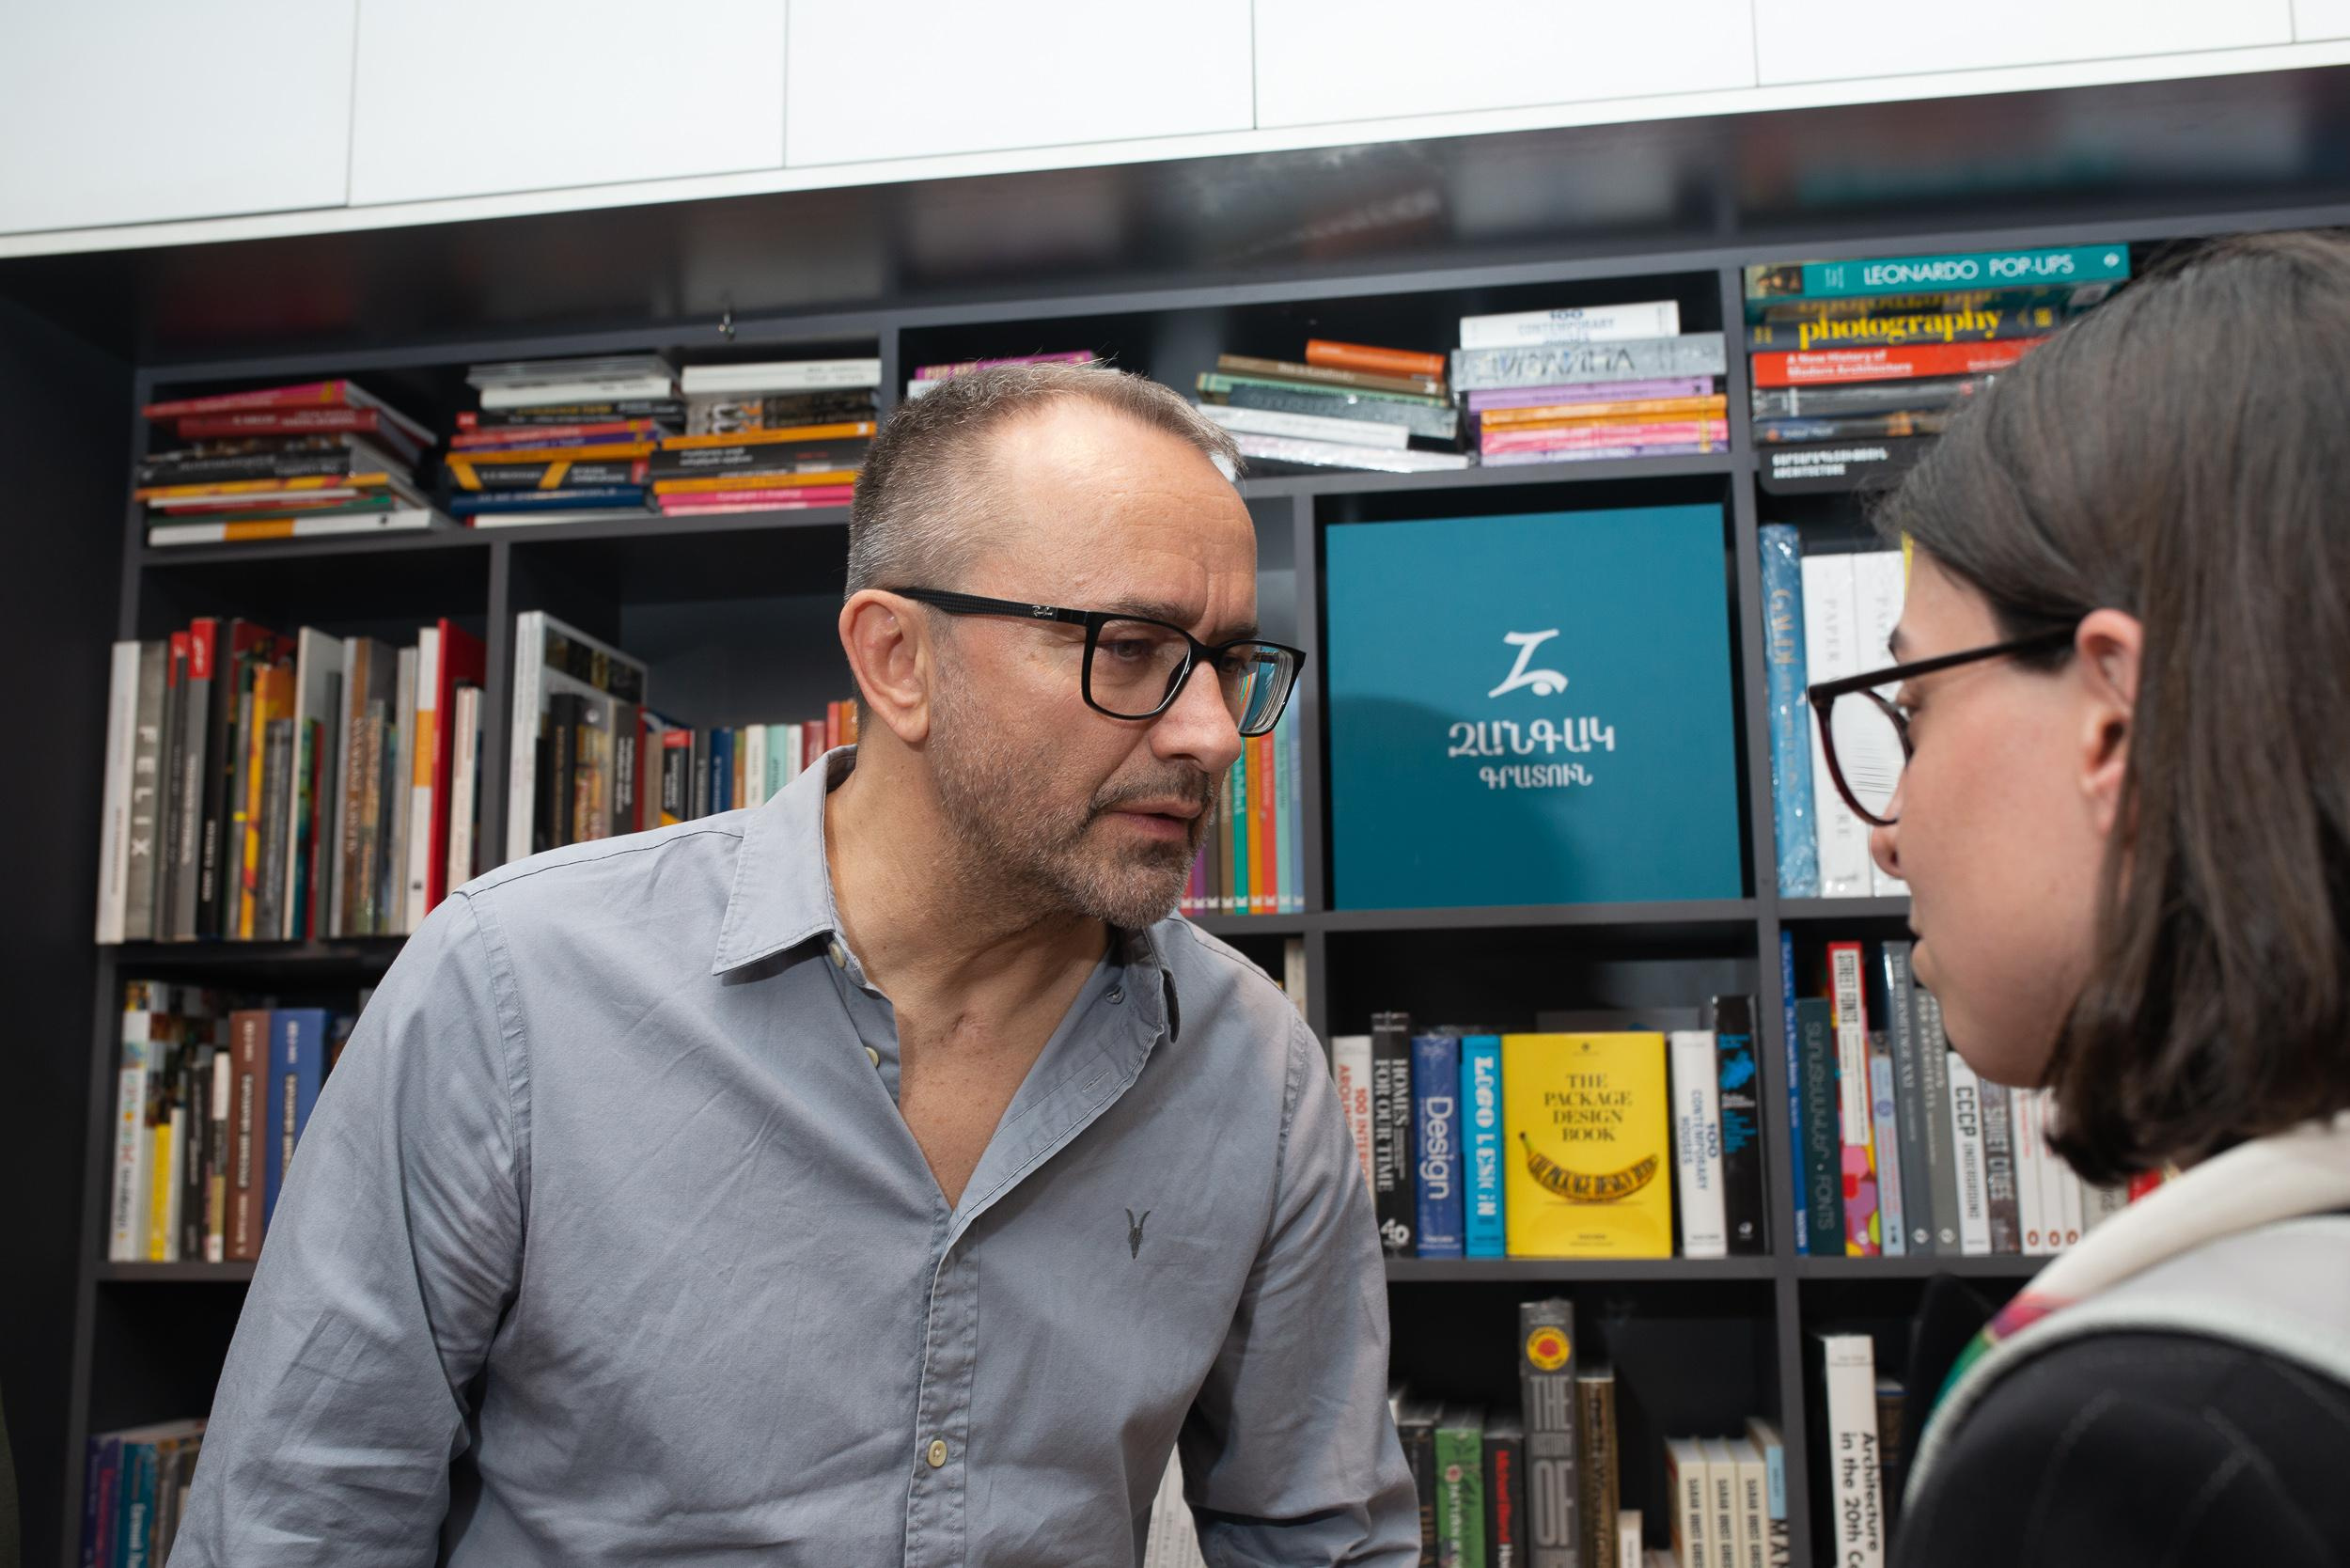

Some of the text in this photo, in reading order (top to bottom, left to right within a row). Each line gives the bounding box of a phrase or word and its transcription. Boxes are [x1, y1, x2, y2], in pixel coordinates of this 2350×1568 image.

[1863, 254, 2076, 287] LEONARDO POP-UPS
[1797, 306, 2004, 352] photography
[1448, 715, 1616, 758] ԶԱՆԳԱԿ
[131, 725, 159, 857] FELIX
[1838, 953, 1858, 1025] STREET FONTS
[1339, 1064, 1354, 1128] AROUN
[1391, 1058, 1409, 1127] HOMES
[1543, 1090, 1633, 1106] PACKAGE
[1566, 1073, 1609, 1090] THE
[1355, 1087, 1372, 1186] 100 INTERIO
[1374, 1058, 1395, 1193] FOR OUR TIME
[1553, 1107, 1624, 1125] DESIGN
[1561, 1126, 1616, 1142] BOOK
[1955, 1085, 1977, 1137] CCCP
[1984, 1105, 2008, 1154] SOVIET
[1419, 1095, 1454, 1200] Design
[1692, 1089, 1708, 1190] CONTEMPORARY
[1706, 1122, 1719, 1158] 100
[1815, 1172, 1835, 1231] FONTS
[1529, 1374, 1571, 1432] THE
[1840, 1432, 1857, 1450] in
[1842, 1458, 1860, 1488] the
[1860, 1432, 1880, 1552] Architecture
[1534, 1459, 1574, 1546] OF
[1843, 1497, 1862, 1542] 20th
